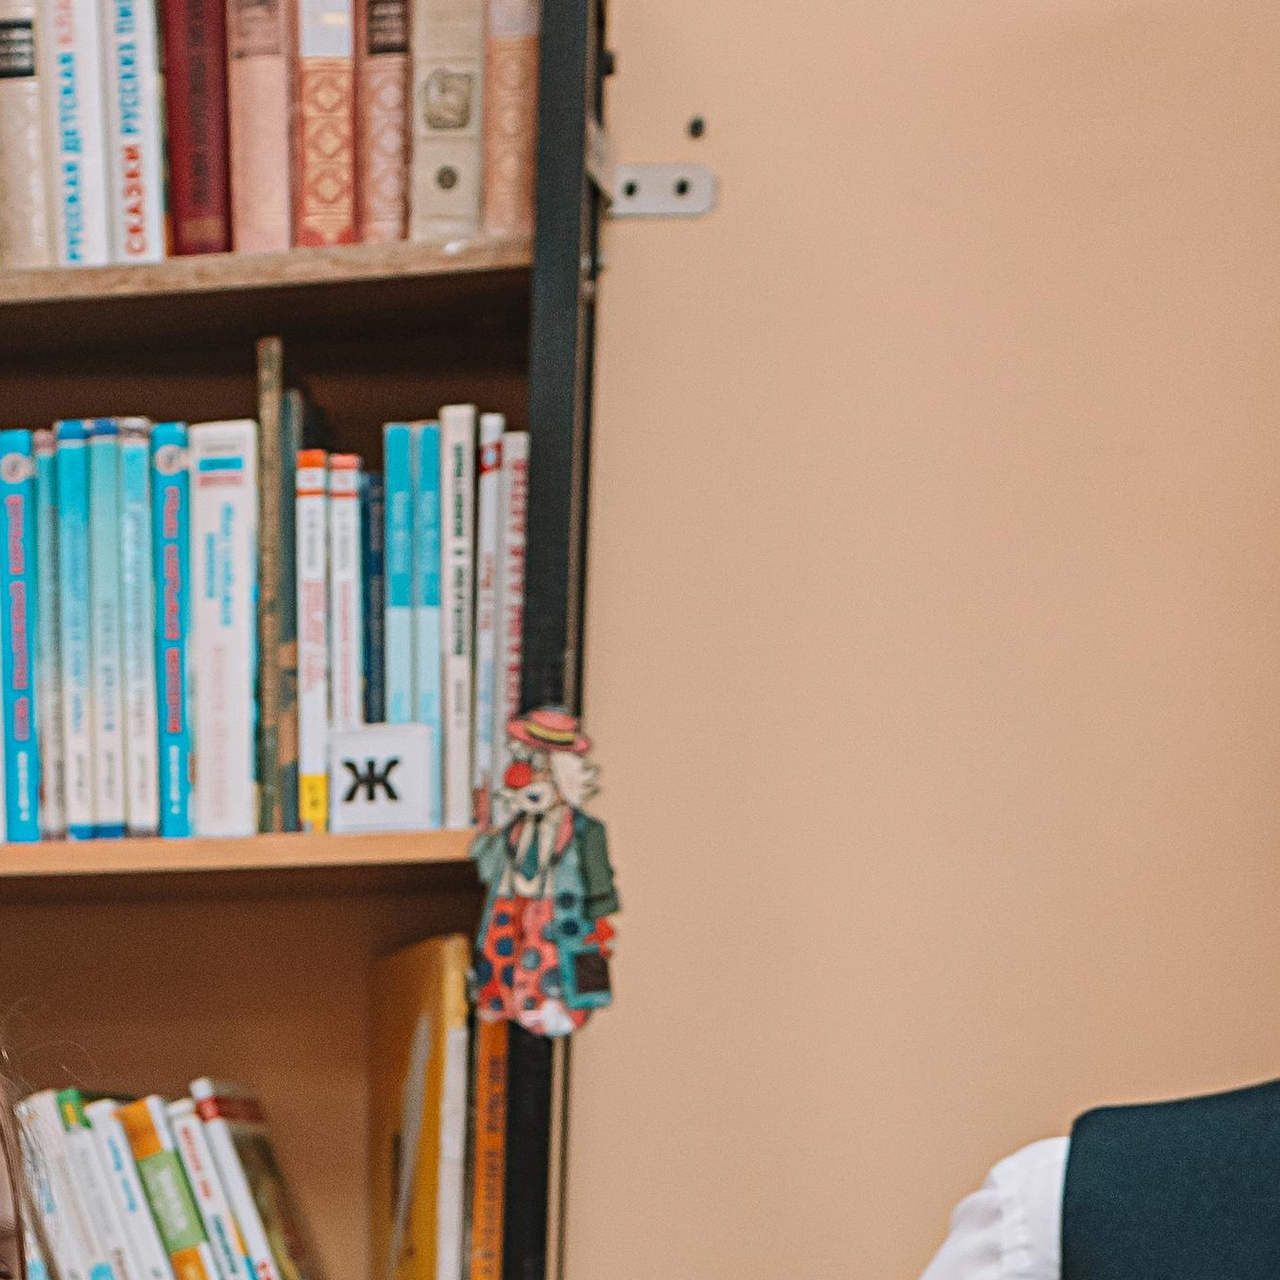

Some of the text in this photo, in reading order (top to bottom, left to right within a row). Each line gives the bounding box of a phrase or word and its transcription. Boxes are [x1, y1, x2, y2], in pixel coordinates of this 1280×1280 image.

[58, 52, 85, 154] ДЕТСКАЯ
[116, 44, 141, 135] РУССКИХ
[60, 160, 85, 262] РУССКАЯ
[122, 144, 148, 257] СКАЗКИ
[342, 757, 400, 802] Ж
